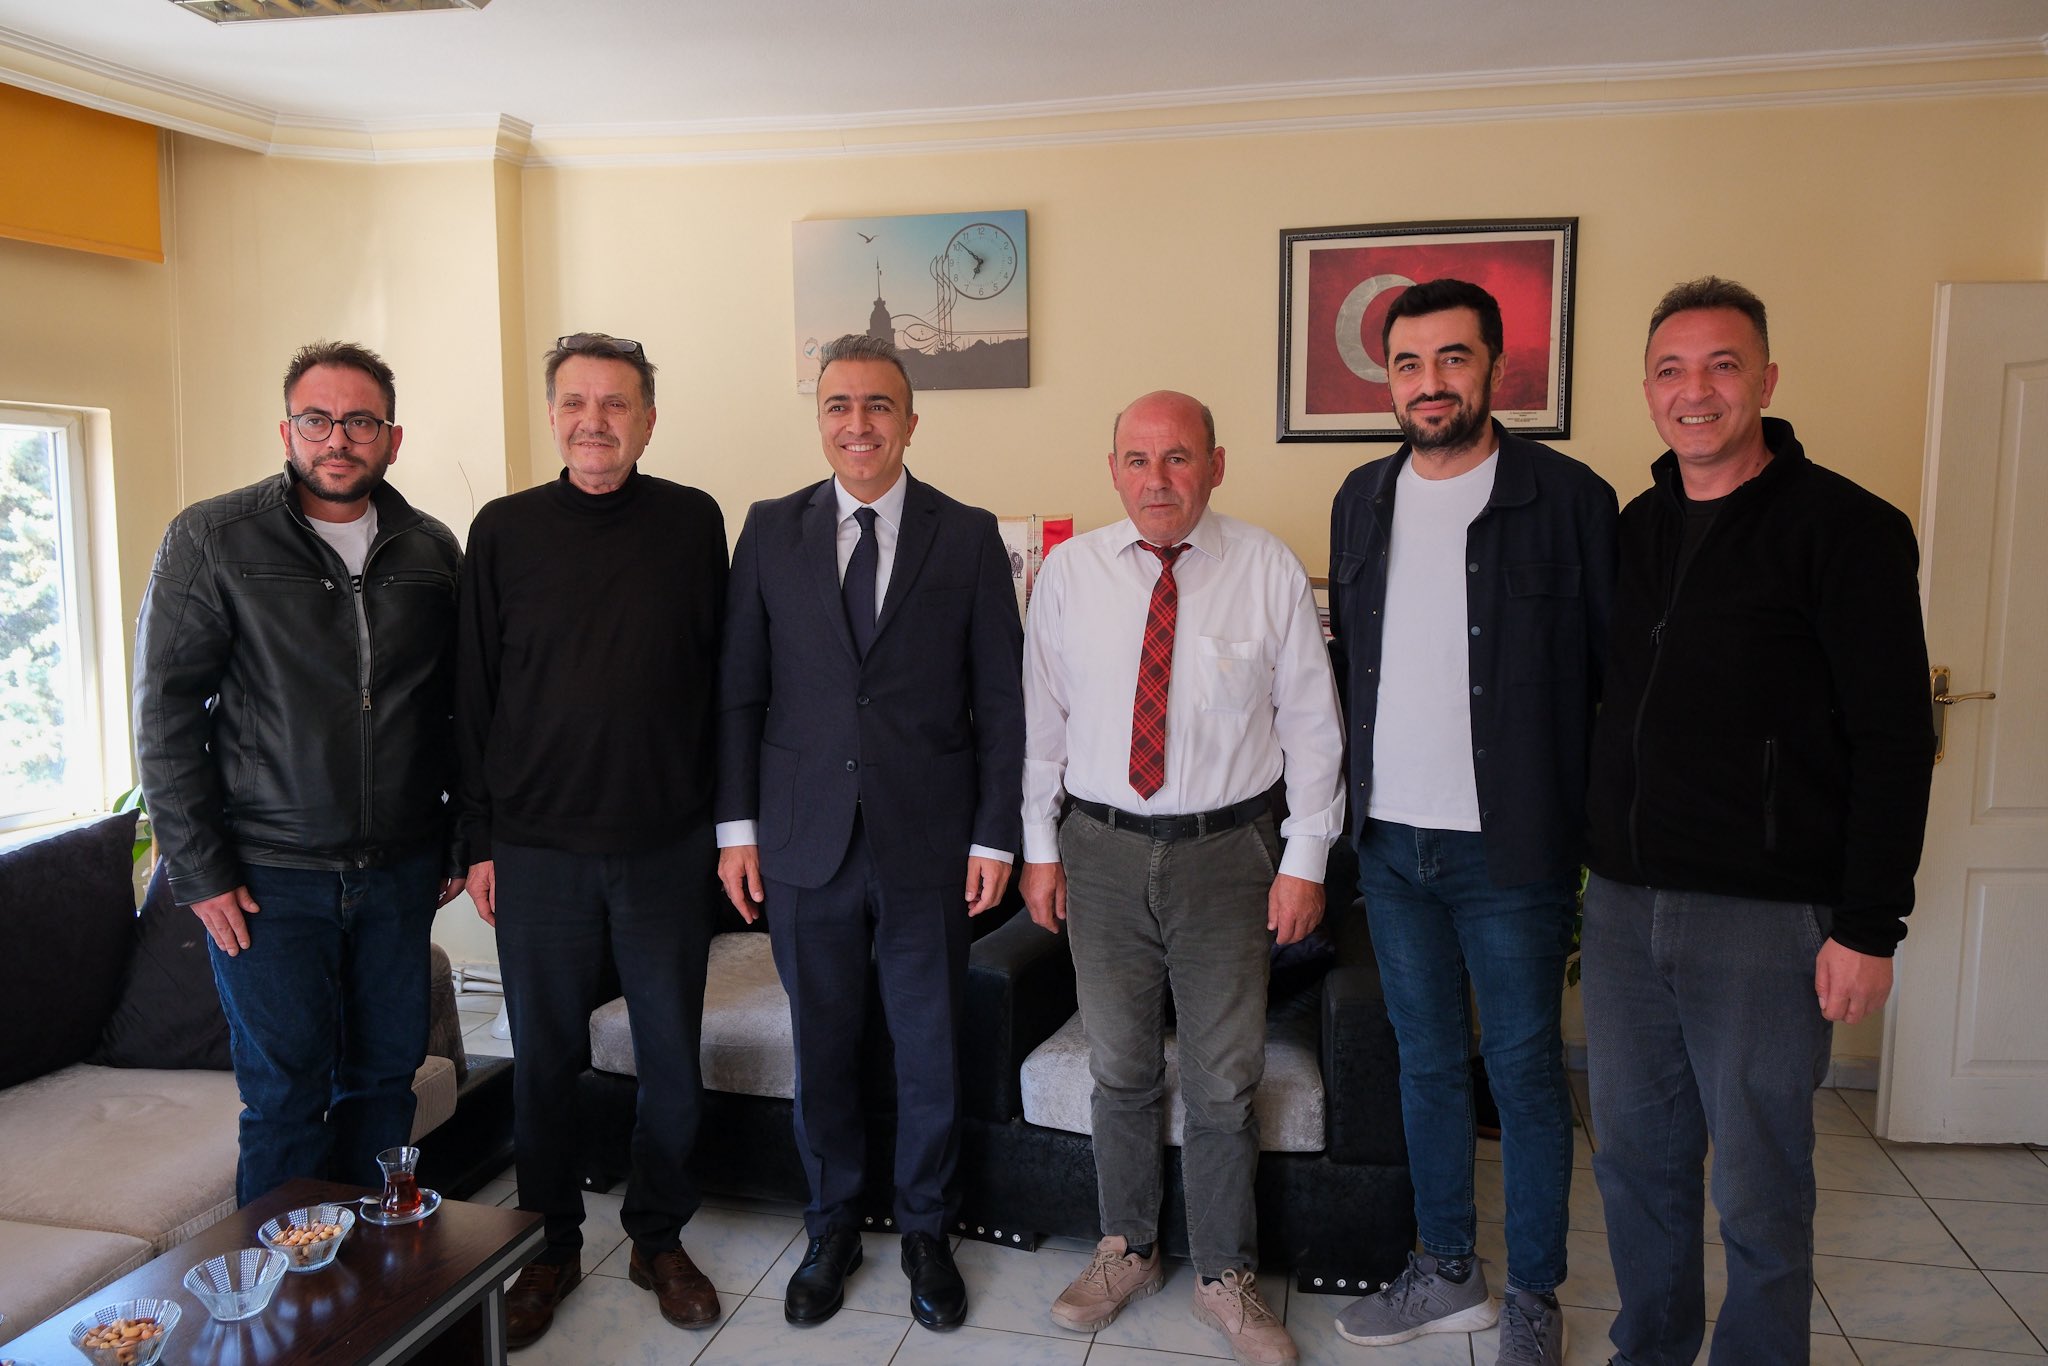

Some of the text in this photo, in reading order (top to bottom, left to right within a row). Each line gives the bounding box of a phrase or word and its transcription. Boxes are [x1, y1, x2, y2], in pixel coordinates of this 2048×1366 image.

[977, 227, 985, 235] 12
[995, 231, 998, 239] 1
[963, 232, 969, 240] 11
[953, 243, 960, 251] 10
[1003, 241, 1009, 250] 2
[949, 259, 954, 267] 9
[1007, 256, 1012, 265] 3
[953, 273, 959, 282] 8
[963, 284, 969, 292] 7
[978, 287, 984, 296] 6
[993, 283, 998, 292] 5
